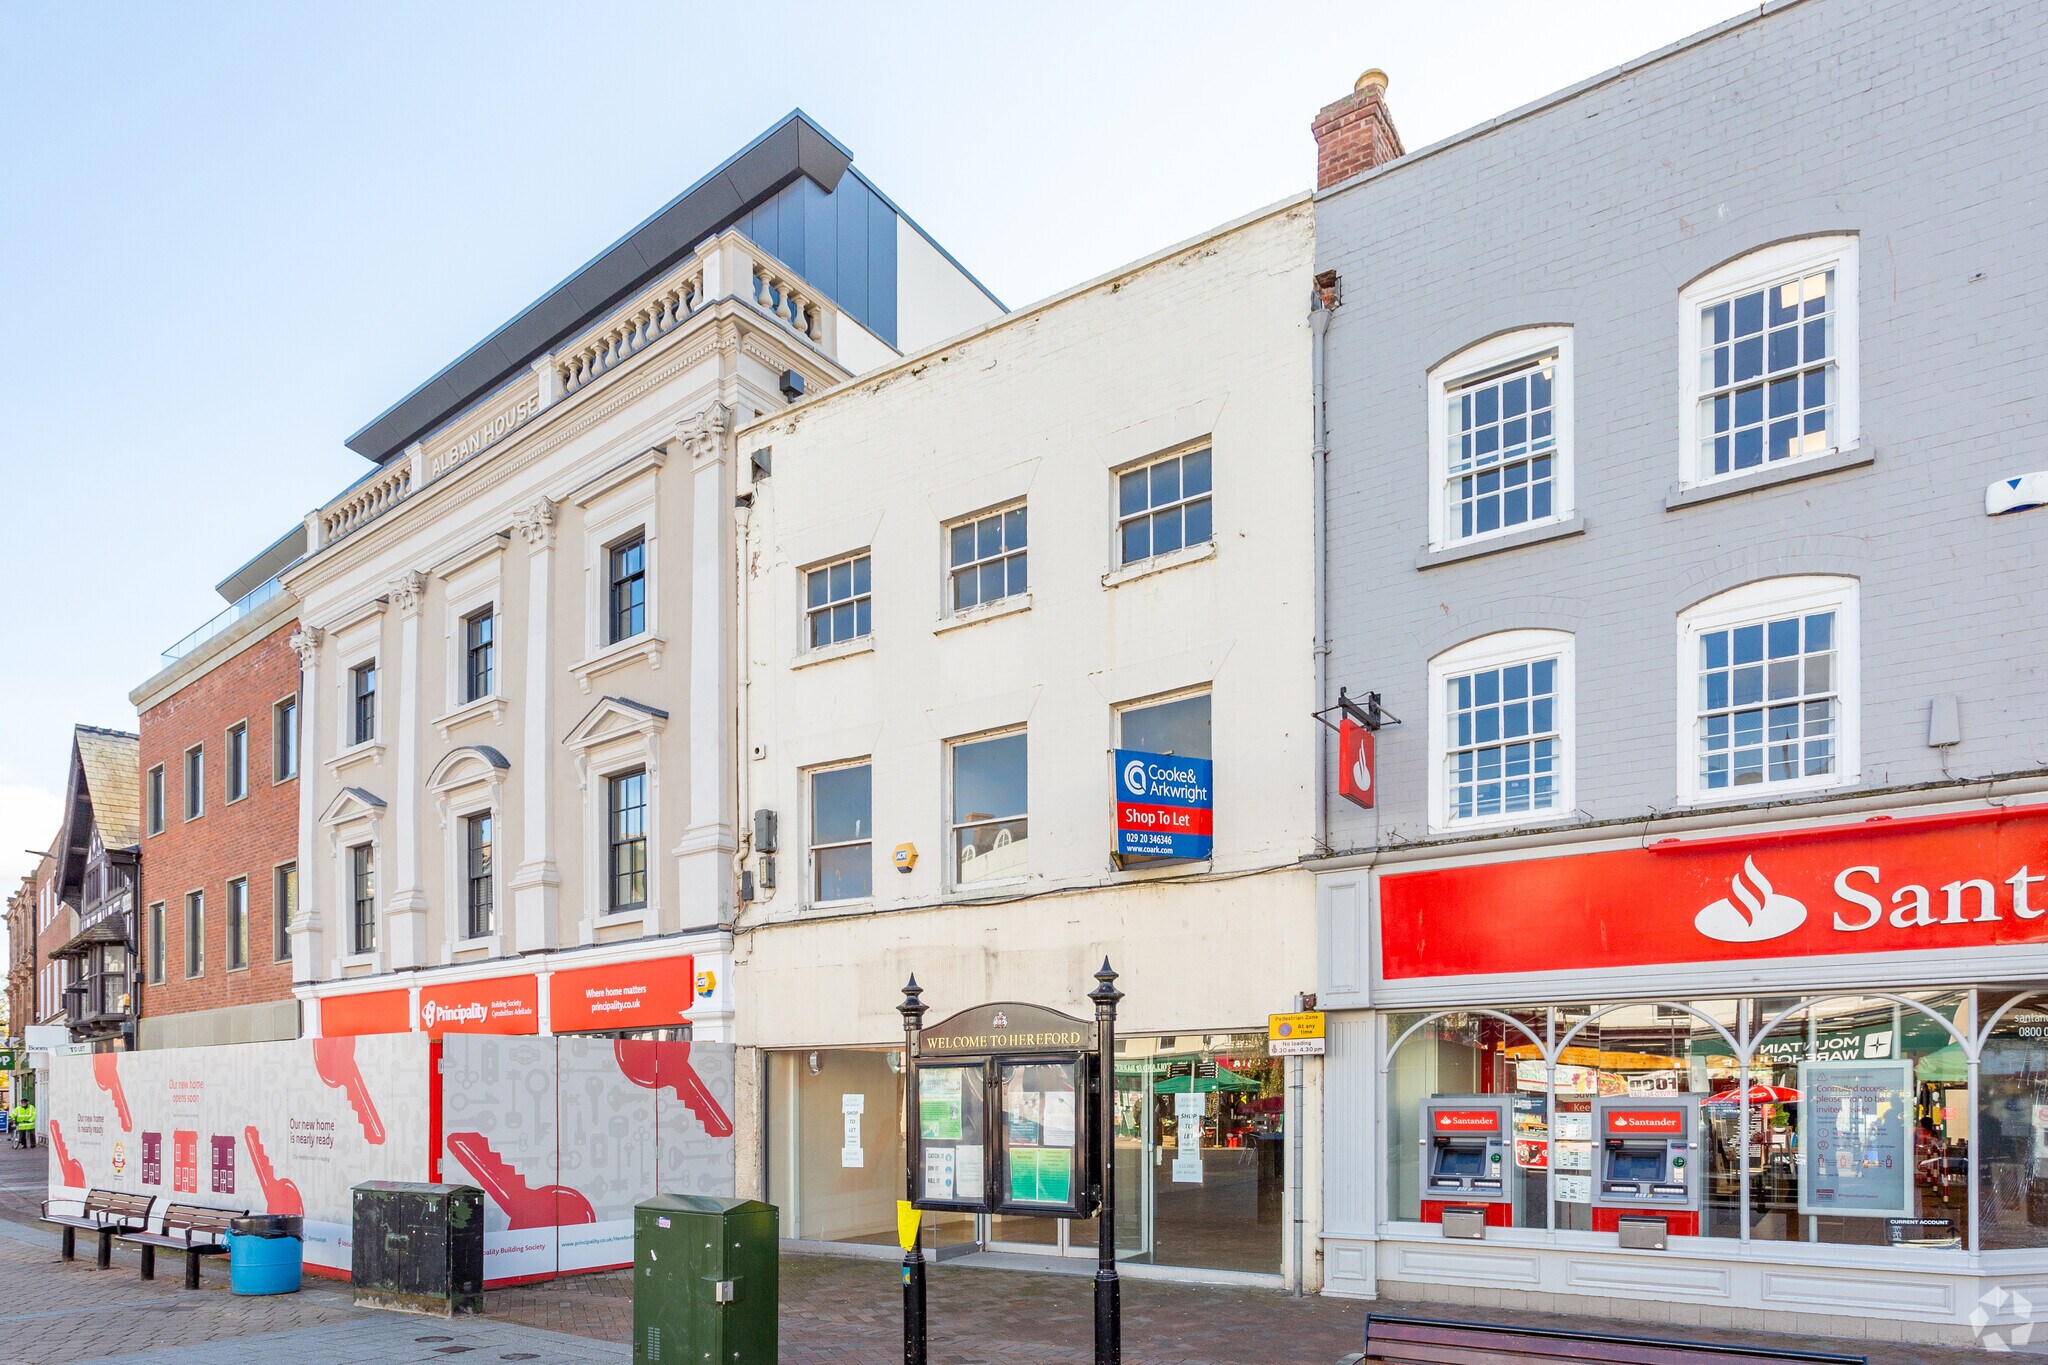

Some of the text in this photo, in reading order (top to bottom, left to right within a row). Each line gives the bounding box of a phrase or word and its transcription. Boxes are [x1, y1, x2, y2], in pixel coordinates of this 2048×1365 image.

[432, 391, 539, 477] ALBAN HOUSE
[1148, 764, 1196, 784] Cooke&
[1149, 781, 1207, 803] Arkwright
[1126, 808, 1190, 827] Shop To Let
[1126, 832, 1172, 845] 029 20 346346
[1126, 844, 1174, 854] www.coark.com
[586, 985, 646, 998] Where home matters
[591, 998, 640, 1013] principality.co.uk
[436, 1002, 488, 1024] Principality
[2018, 1026, 2042, 1036] 0800
[927, 1032, 1080, 1048] WELCOME TO HEREFORD
[169, 1079, 204, 1090] Our new home
[290, 1118, 334, 1131] Our new home
[1452, 1116, 1494, 1125] Santander
[1629, 1117, 1676, 1126] Santander
[290, 1132, 334, 1148] is nearly ready
[500, 1246, 524, 1256] Building
[525, 1244, 546, 1252] Society
